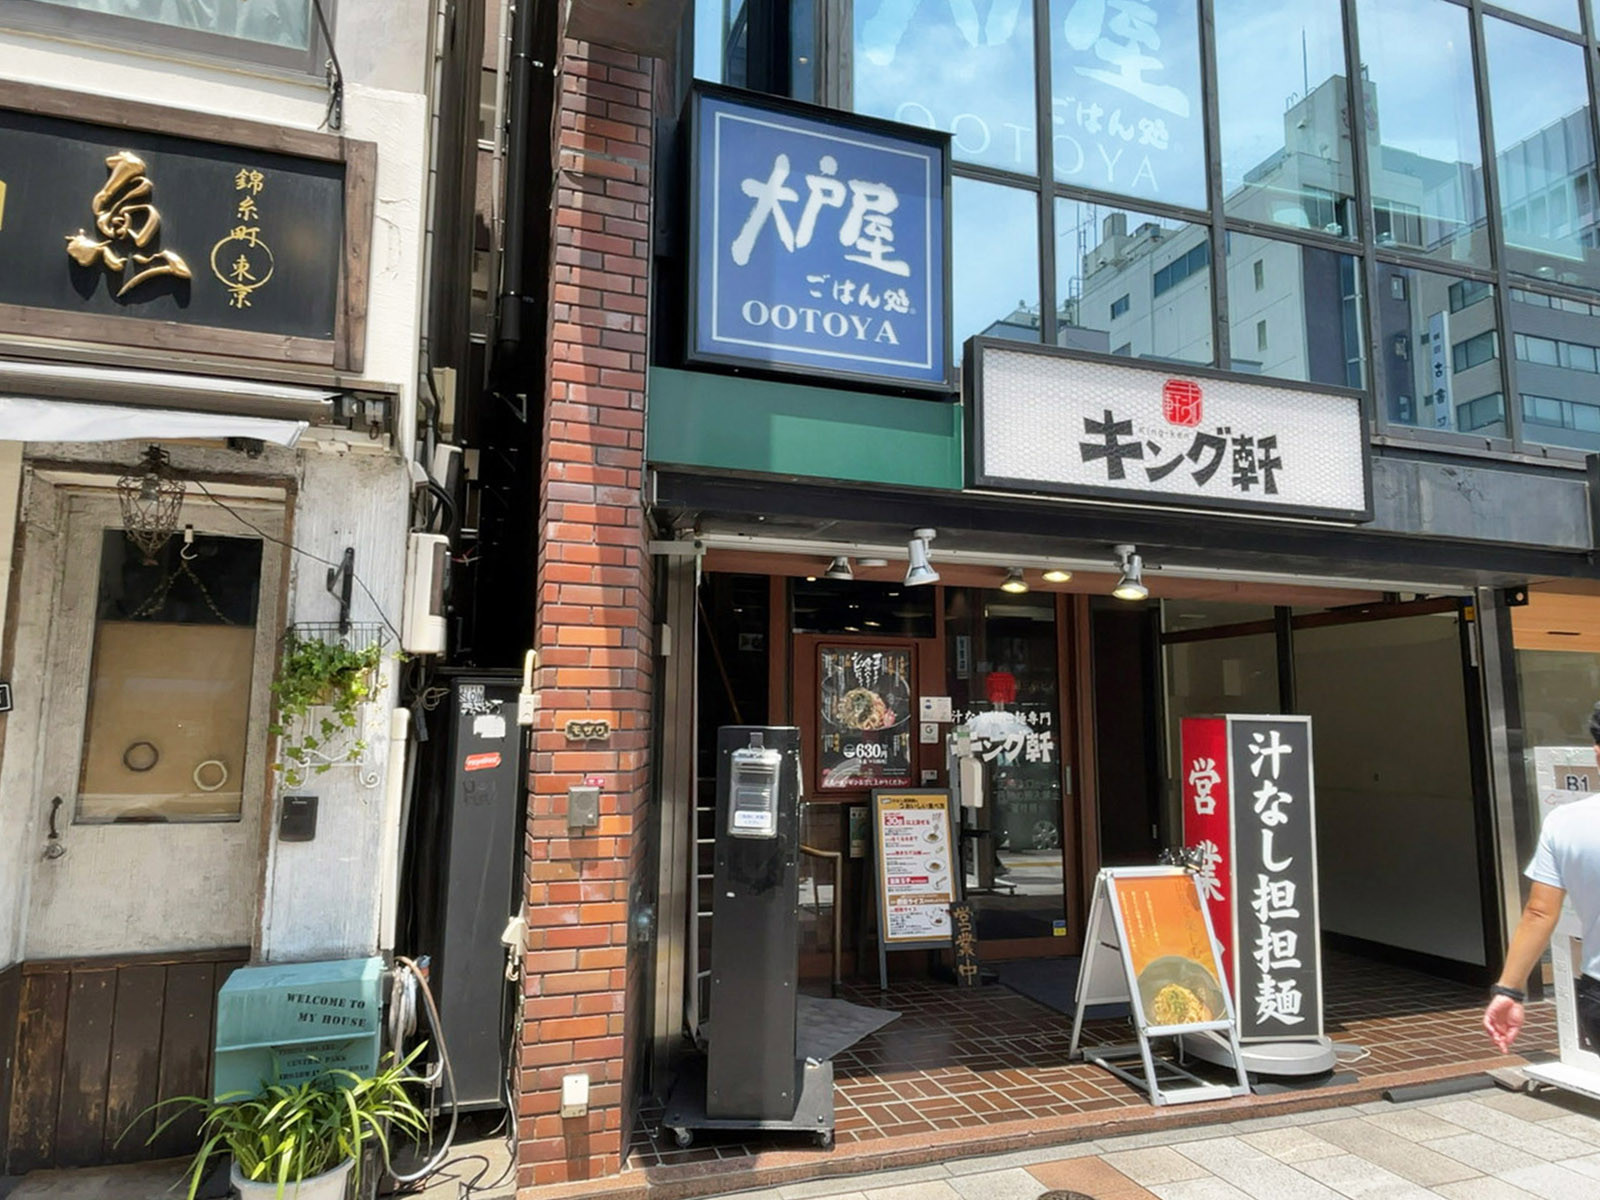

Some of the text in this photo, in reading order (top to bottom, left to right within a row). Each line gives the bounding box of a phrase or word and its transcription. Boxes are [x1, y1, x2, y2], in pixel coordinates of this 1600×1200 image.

[731, 153, 911, 278] 大戸屋
[806, 274, 910, 314] ごはん処
[742, 300, 900, 345] OOTOYA
[1079, 409, 1283, 495] キング軒
[1566, 775, 1588, 792] B1
[1249, 730, 1305, 1026] 汁なし担担麺
[287, 993, 366, 1009] WELCOME TO
[299, 1012, 367, 1027] MY HOUSE
